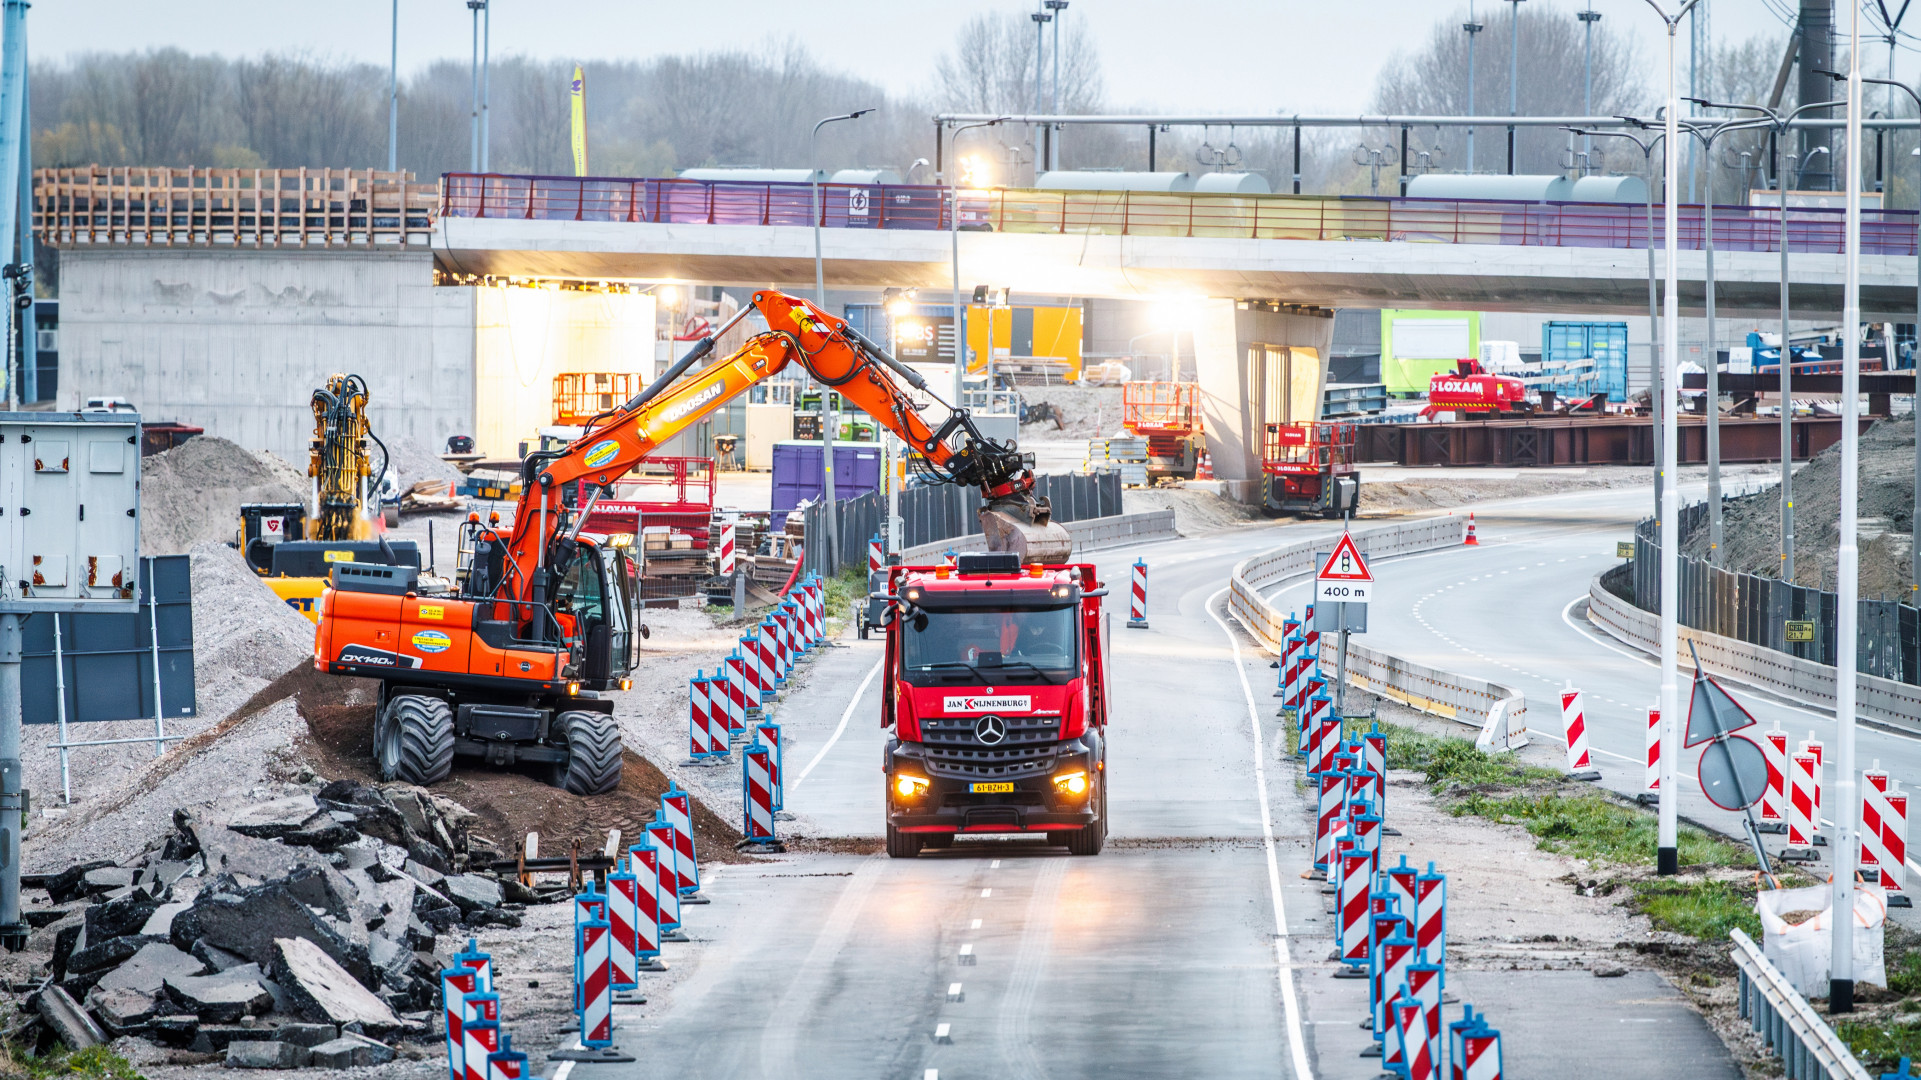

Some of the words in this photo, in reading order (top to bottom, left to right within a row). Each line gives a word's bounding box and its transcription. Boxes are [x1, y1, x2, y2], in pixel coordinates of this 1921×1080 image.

[1438, 382, 1483, 393] LOXAM
[1324, 587, 1349, 596] 400
[964, 698, 1023, 710] KNIJNENBURG
[976, 783, 1010, 792] 61-BZH-3
